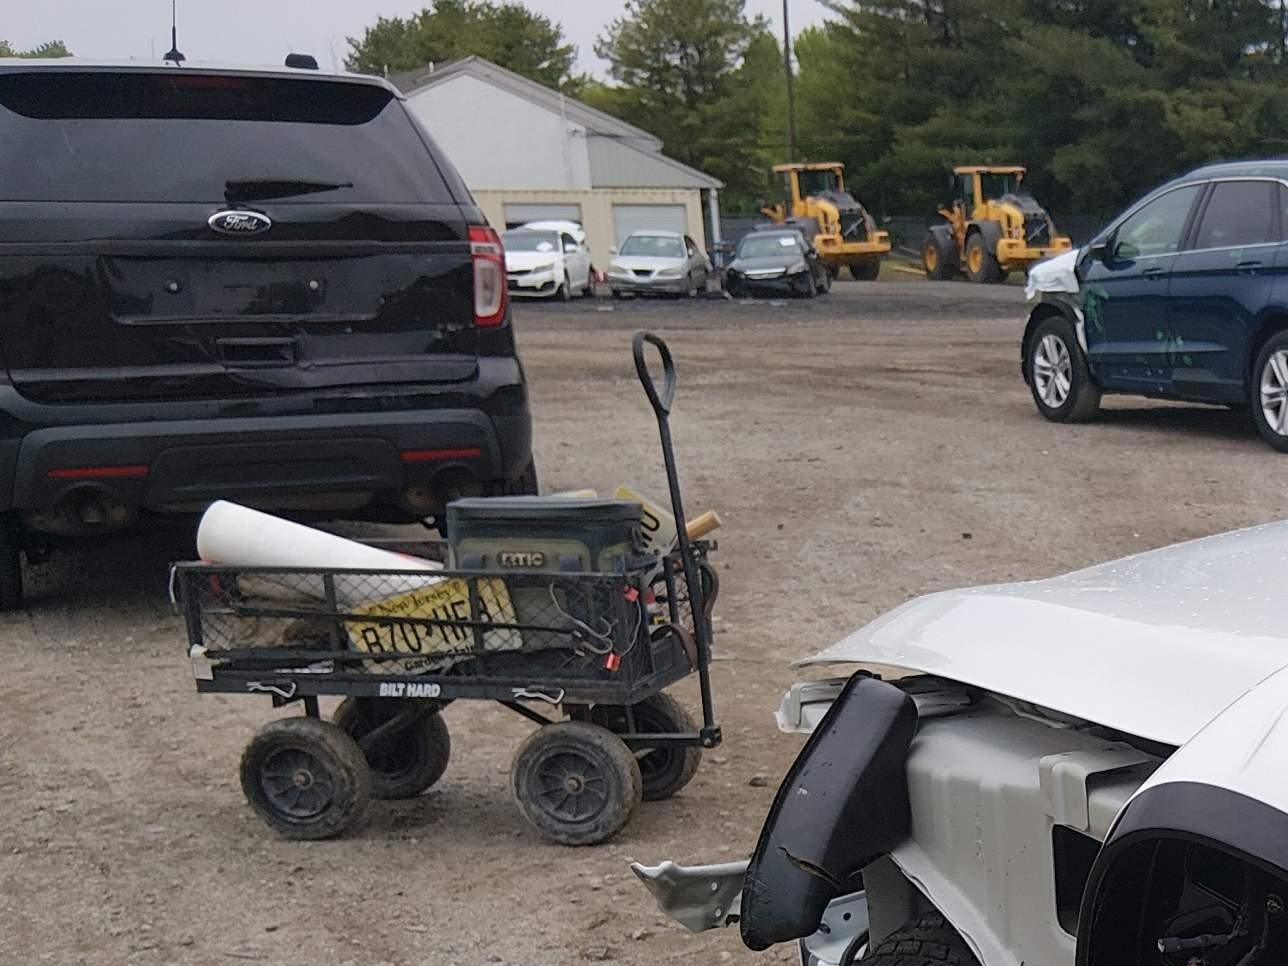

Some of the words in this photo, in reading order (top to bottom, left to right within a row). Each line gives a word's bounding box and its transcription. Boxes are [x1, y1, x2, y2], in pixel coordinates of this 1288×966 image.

[223, 214, 258, 230] Ford
[380, 682, 406, 697] BILT
[407, 683, 441, 698] HARD
